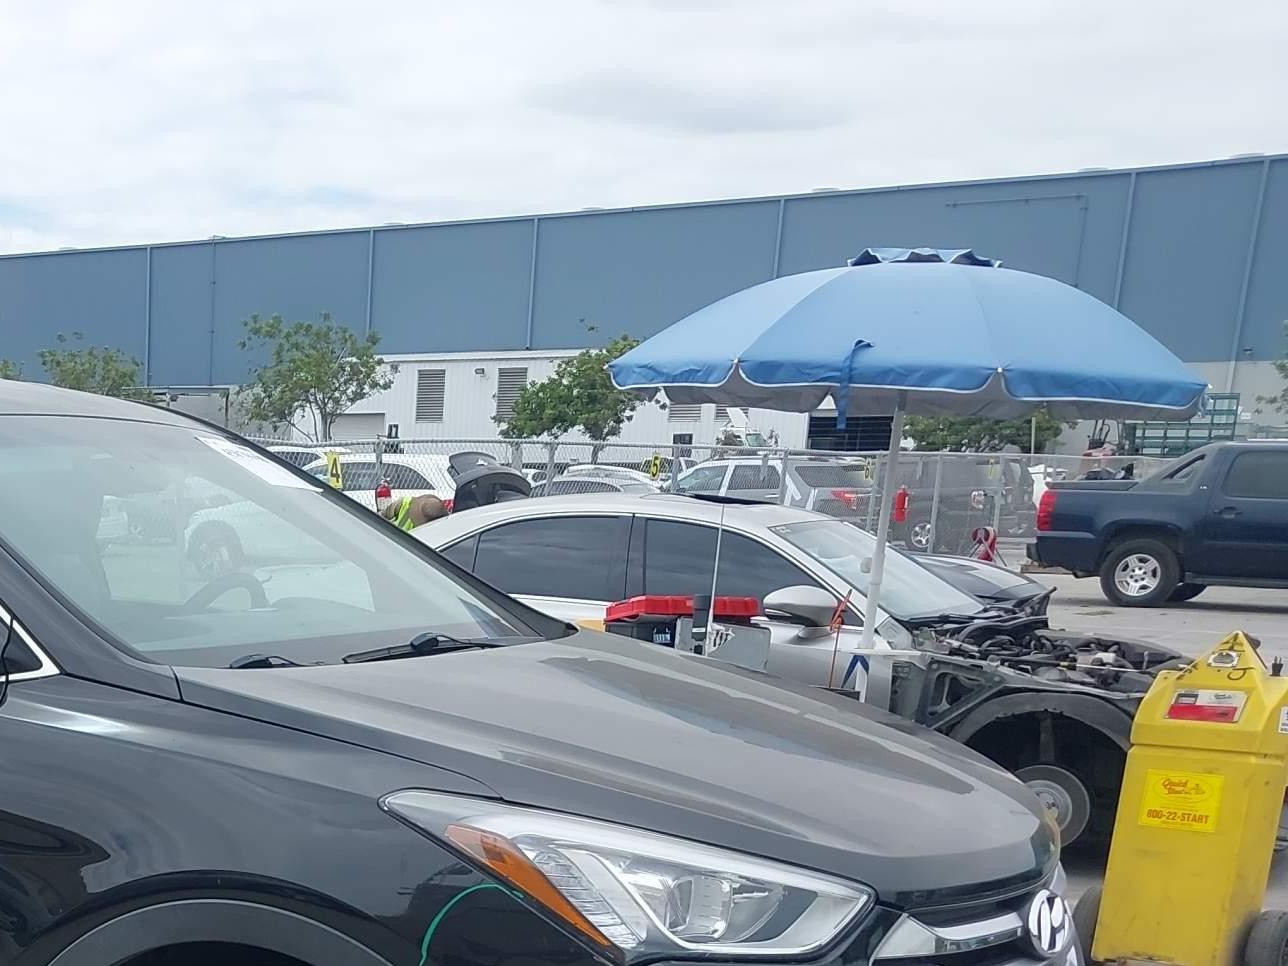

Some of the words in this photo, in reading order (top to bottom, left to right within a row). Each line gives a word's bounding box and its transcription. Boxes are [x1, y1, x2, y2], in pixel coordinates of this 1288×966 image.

[330, 457, 341, 484] 4
[651, 455, 659, 478] 5
[1147, 809, 1210, 825] 800-22-START
